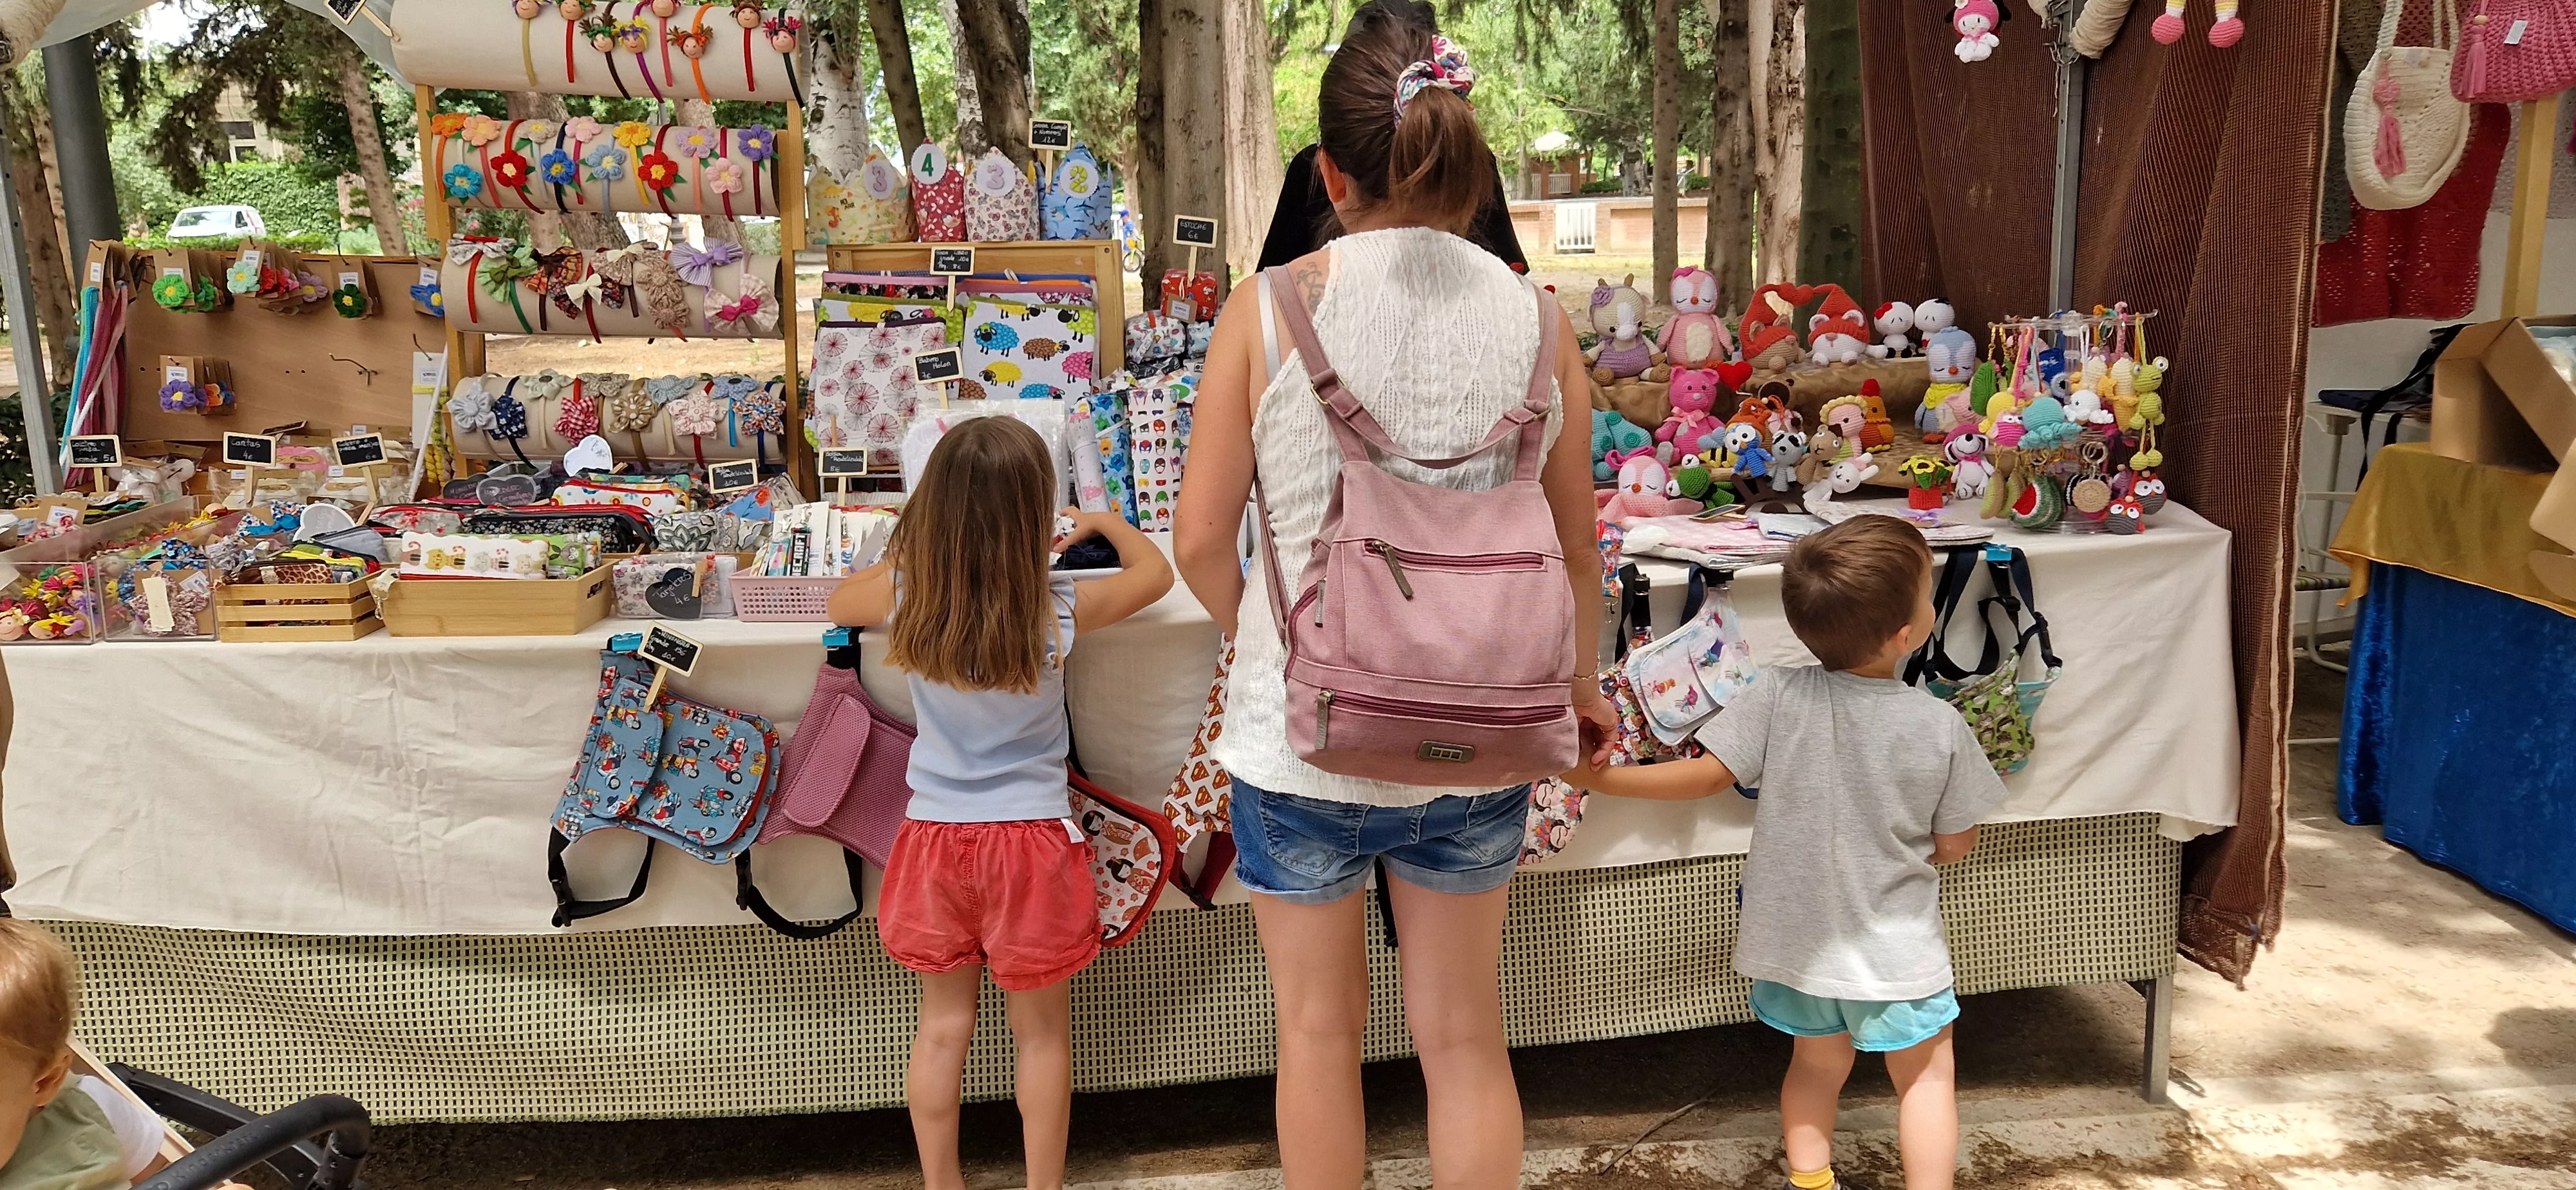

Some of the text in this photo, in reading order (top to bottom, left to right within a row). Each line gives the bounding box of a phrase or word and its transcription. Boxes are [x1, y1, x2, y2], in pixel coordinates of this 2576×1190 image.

[921, 153, 934, 176] 4
[987, 164, 1005, 189] 3
[872, 165, 887, 192] 3
[1069, 165, 1088, 193] 2
[1188, 230, 1198, 239] 6€
